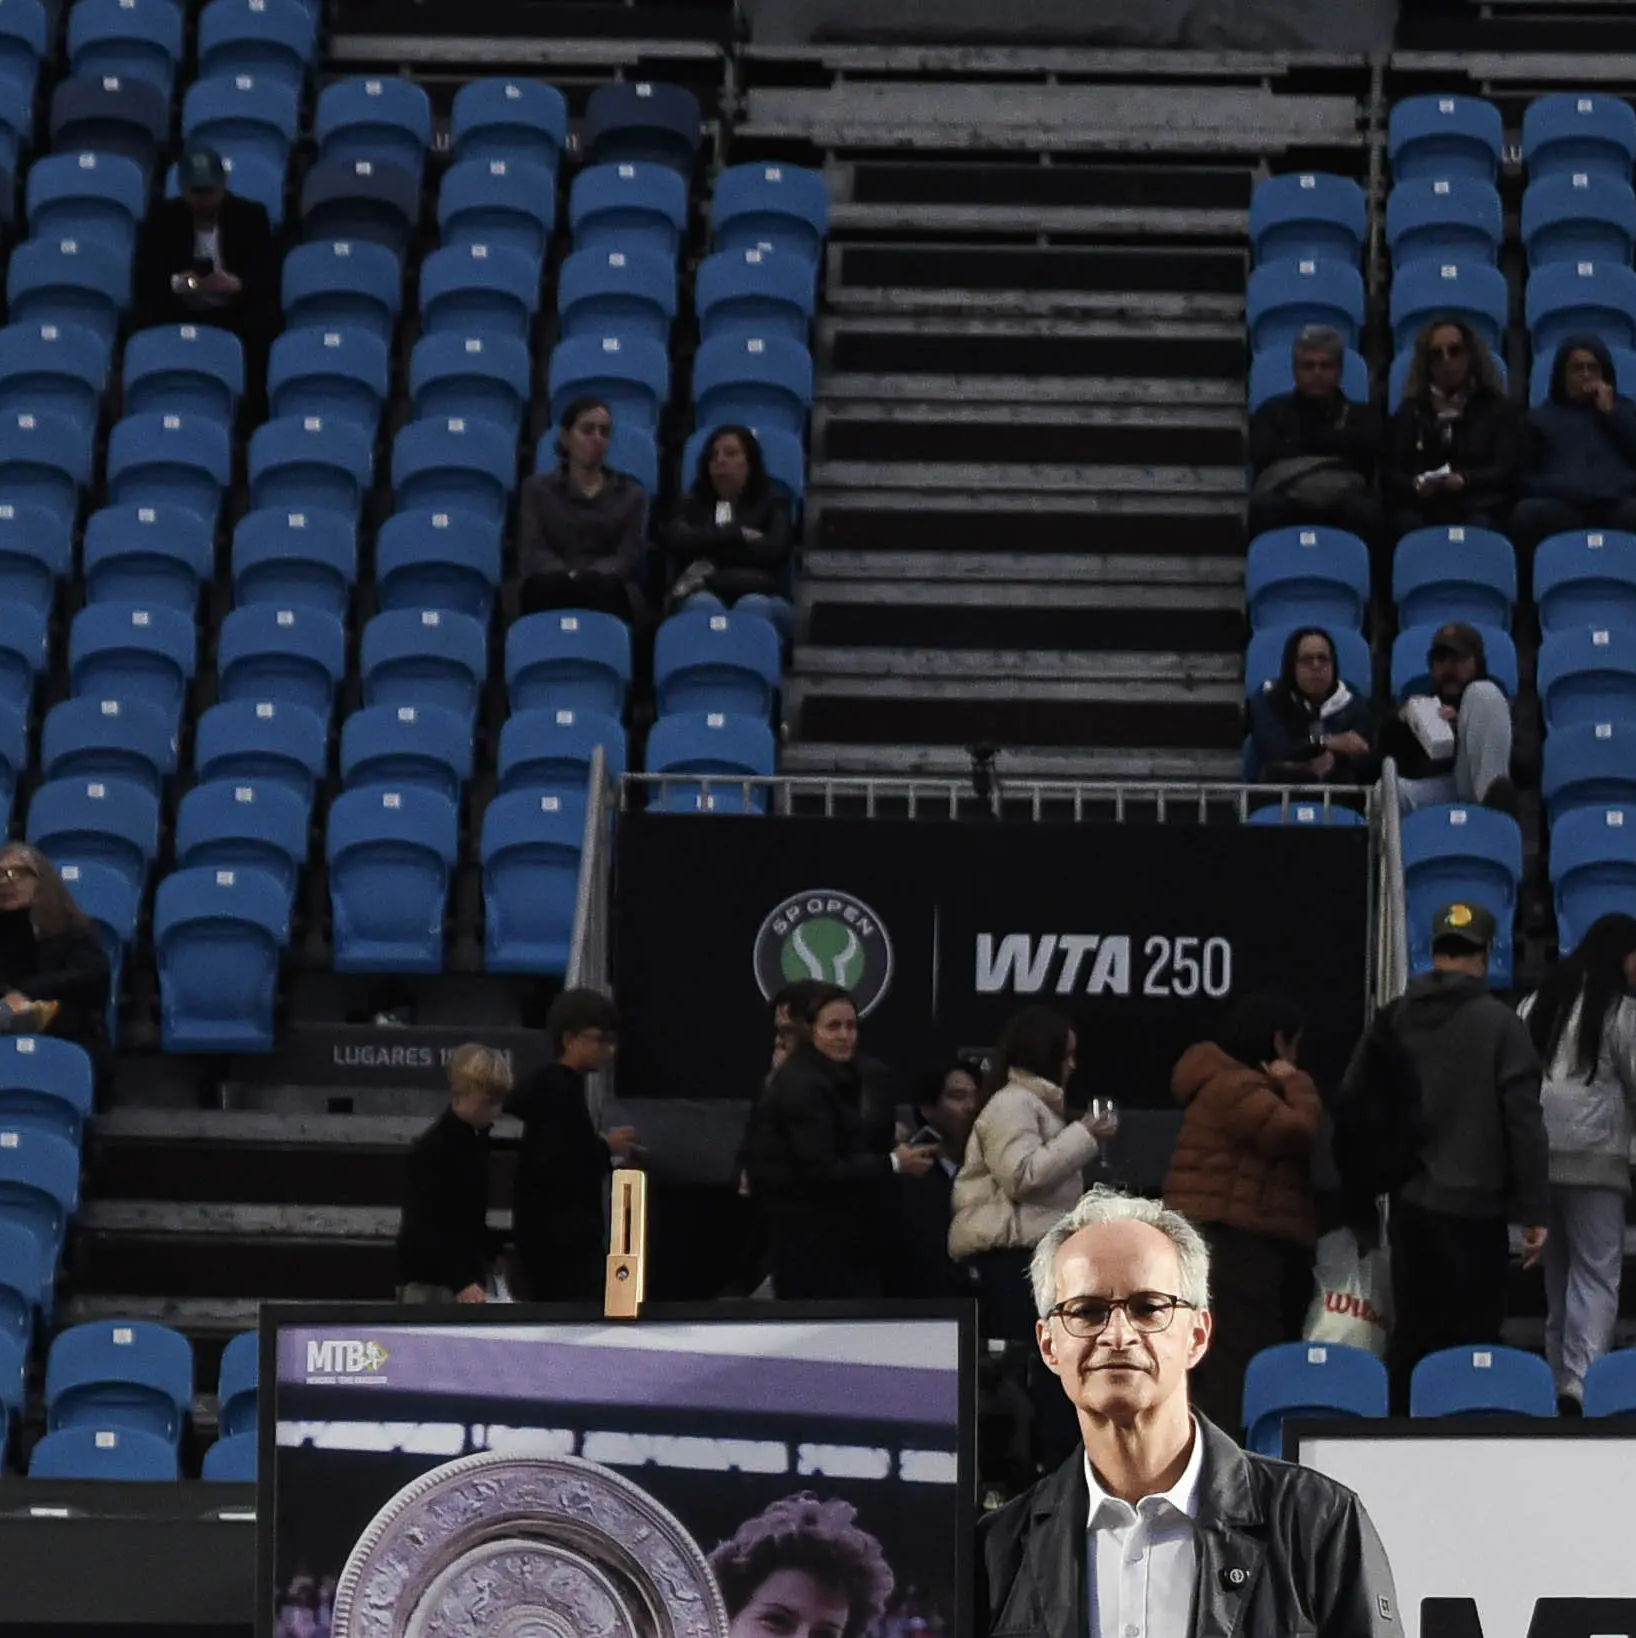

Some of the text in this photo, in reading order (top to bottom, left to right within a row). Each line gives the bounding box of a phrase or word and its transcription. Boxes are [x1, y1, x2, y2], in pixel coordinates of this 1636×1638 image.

[771, 898, 875, 937] SP OPEN
[975, 932, 1232, 998] WTA 250
[333, 1045, 433, 1067] LUGARES
[306, 1340, 365, 1373] MTB
